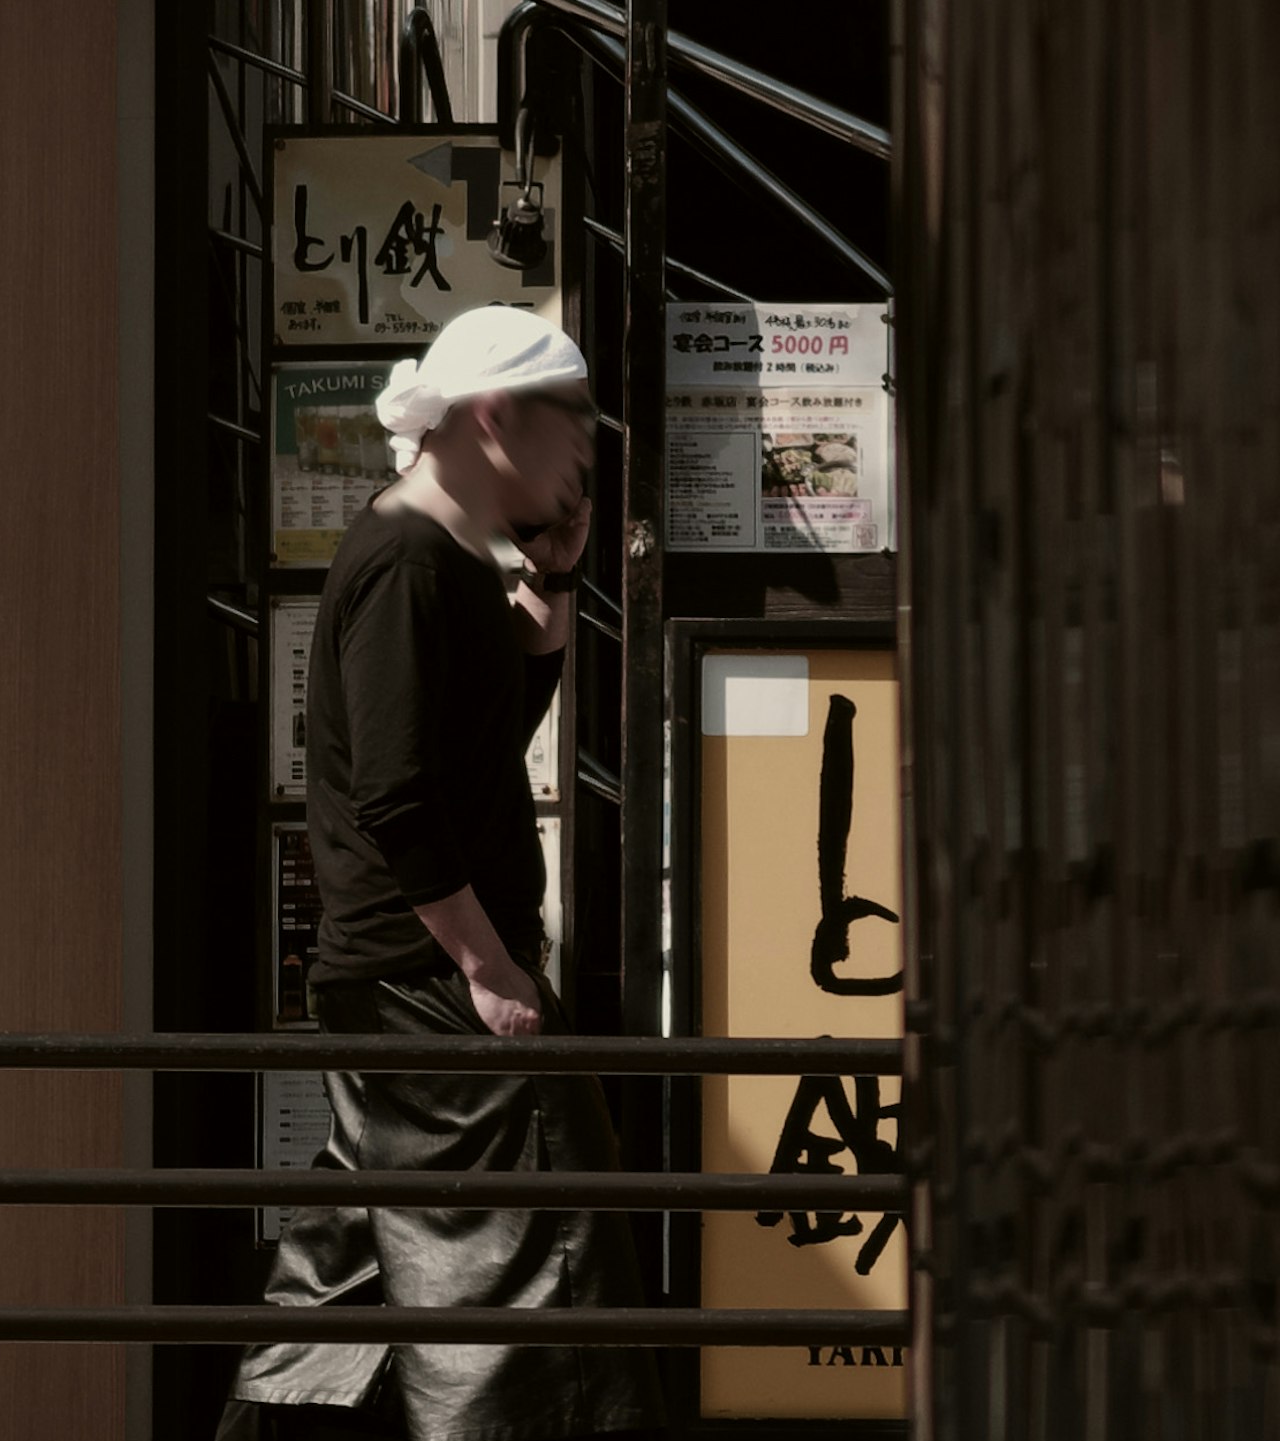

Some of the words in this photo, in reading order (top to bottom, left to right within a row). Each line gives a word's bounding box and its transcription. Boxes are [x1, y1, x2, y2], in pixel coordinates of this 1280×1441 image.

[294, 185, 452, 324] とり鉄
[672, 333, 764, 353] 宴会コース
[771, 335, 823, 354] 5000
[829, 335, 849, 355] 円
[284, 375, 365, 399] TAKUMI
